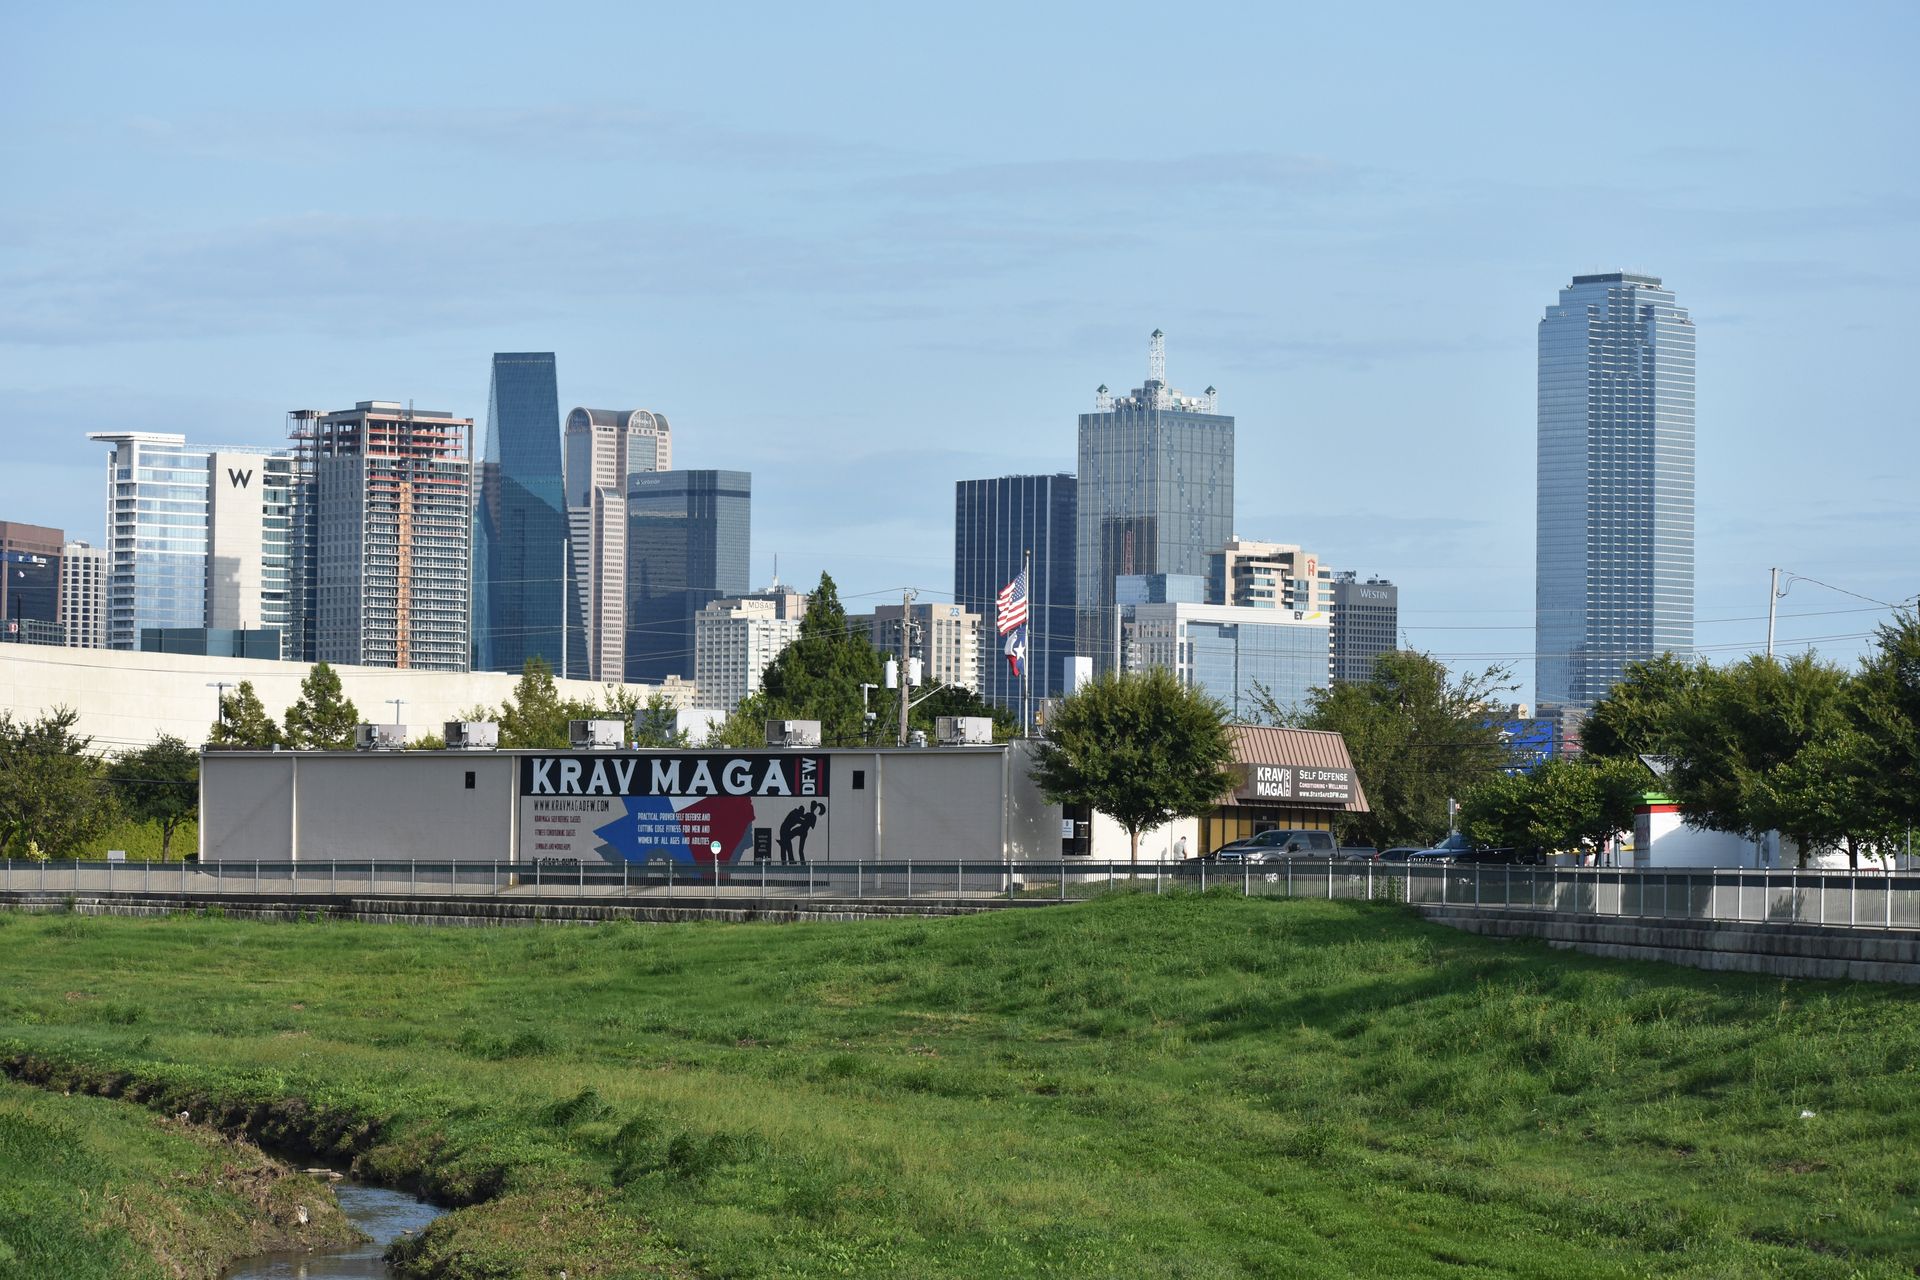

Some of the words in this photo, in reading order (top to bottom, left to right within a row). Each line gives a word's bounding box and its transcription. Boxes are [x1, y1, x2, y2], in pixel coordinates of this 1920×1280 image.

[228, 468, 253, 488] W
[1360, 588, 1388, 599] WESTIN
[949, 607, 960, 617] 23
[1294, 611, 1304, 620] EY
[531, 758, 638, 795] KRAV
[649, 759, 792, 796] MAGA
[802, 757, 817, 795] DFW
[1257, 766, 1284, 782] KRAV
[1299, 769, 1317, 780] SELF
[1318, 770, 1348, 782] DEFENSE
[1257, 781, 1284, 797] MAGA
[533, 799, 609, 812] WWW.KRAVMAGADFW.COM
[682, 824, 691, 833] FOR
[691, 825, 701, 833] MEN
[701, 825, 711, 833] AND
[637, 836, 653, 845] WOMEN
[653, 836, 660, 845] OF
[660, 836, 669, 845] ALL
[681, 836, 690, 845] AND
